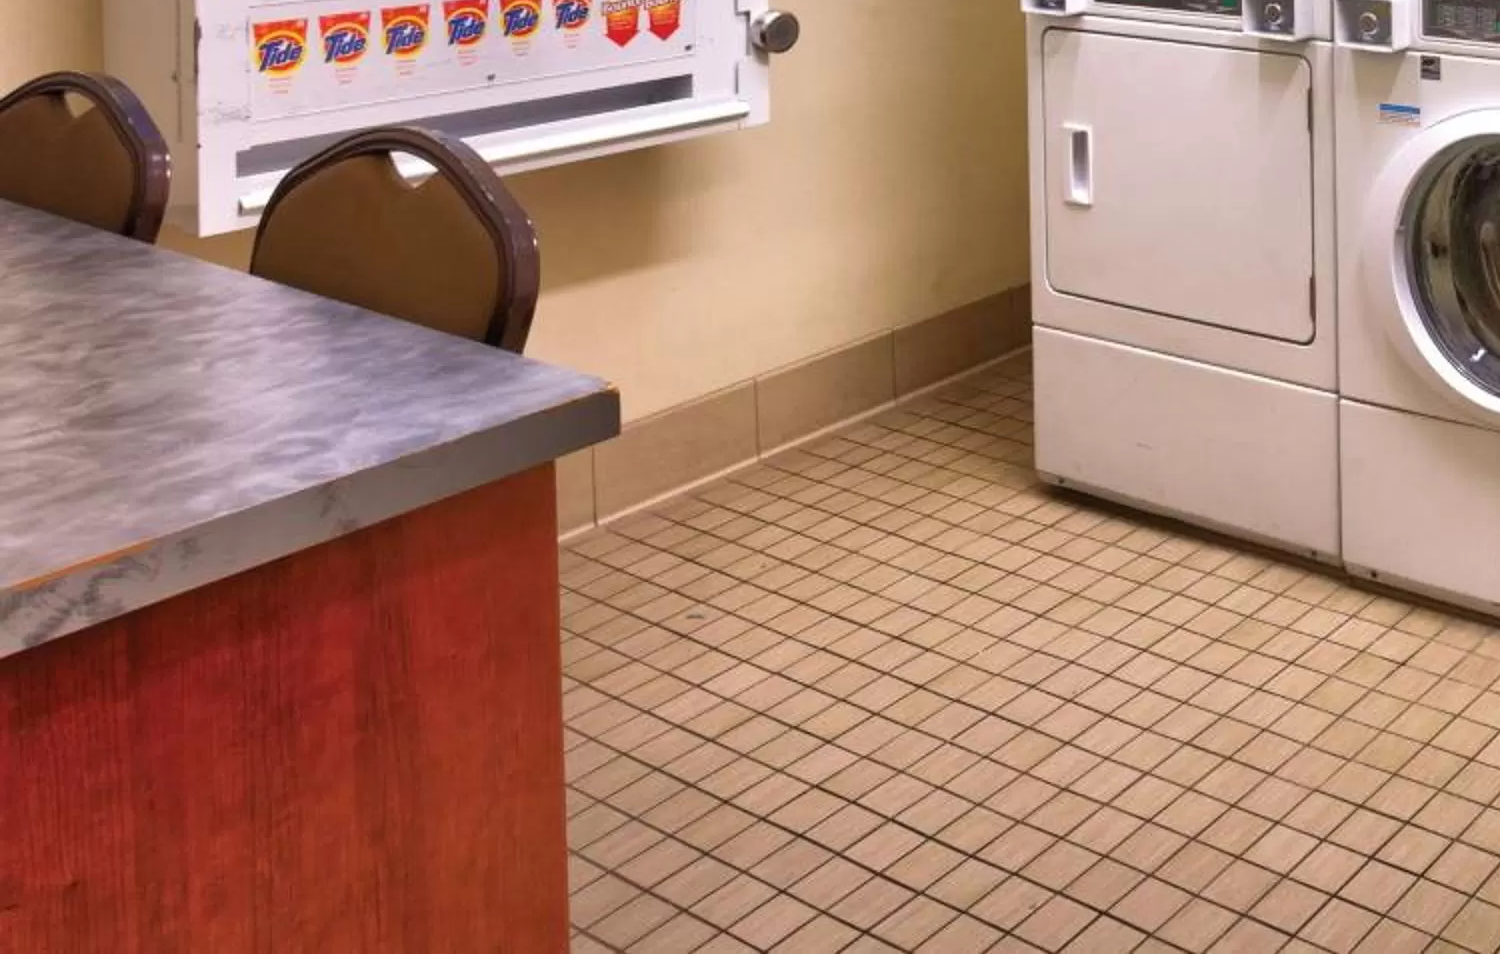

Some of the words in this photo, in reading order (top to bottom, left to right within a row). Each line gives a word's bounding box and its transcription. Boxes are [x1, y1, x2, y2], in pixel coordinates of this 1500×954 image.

[448, 16, 485, 45] Tide
[504, 7, 538, 37] Tide
[556, 1, 589, 29] Tide
[325, 31, 367, 63] Tide
[385, 23, 425, 55] Tide
[258, 39, 303, 72] Tide
